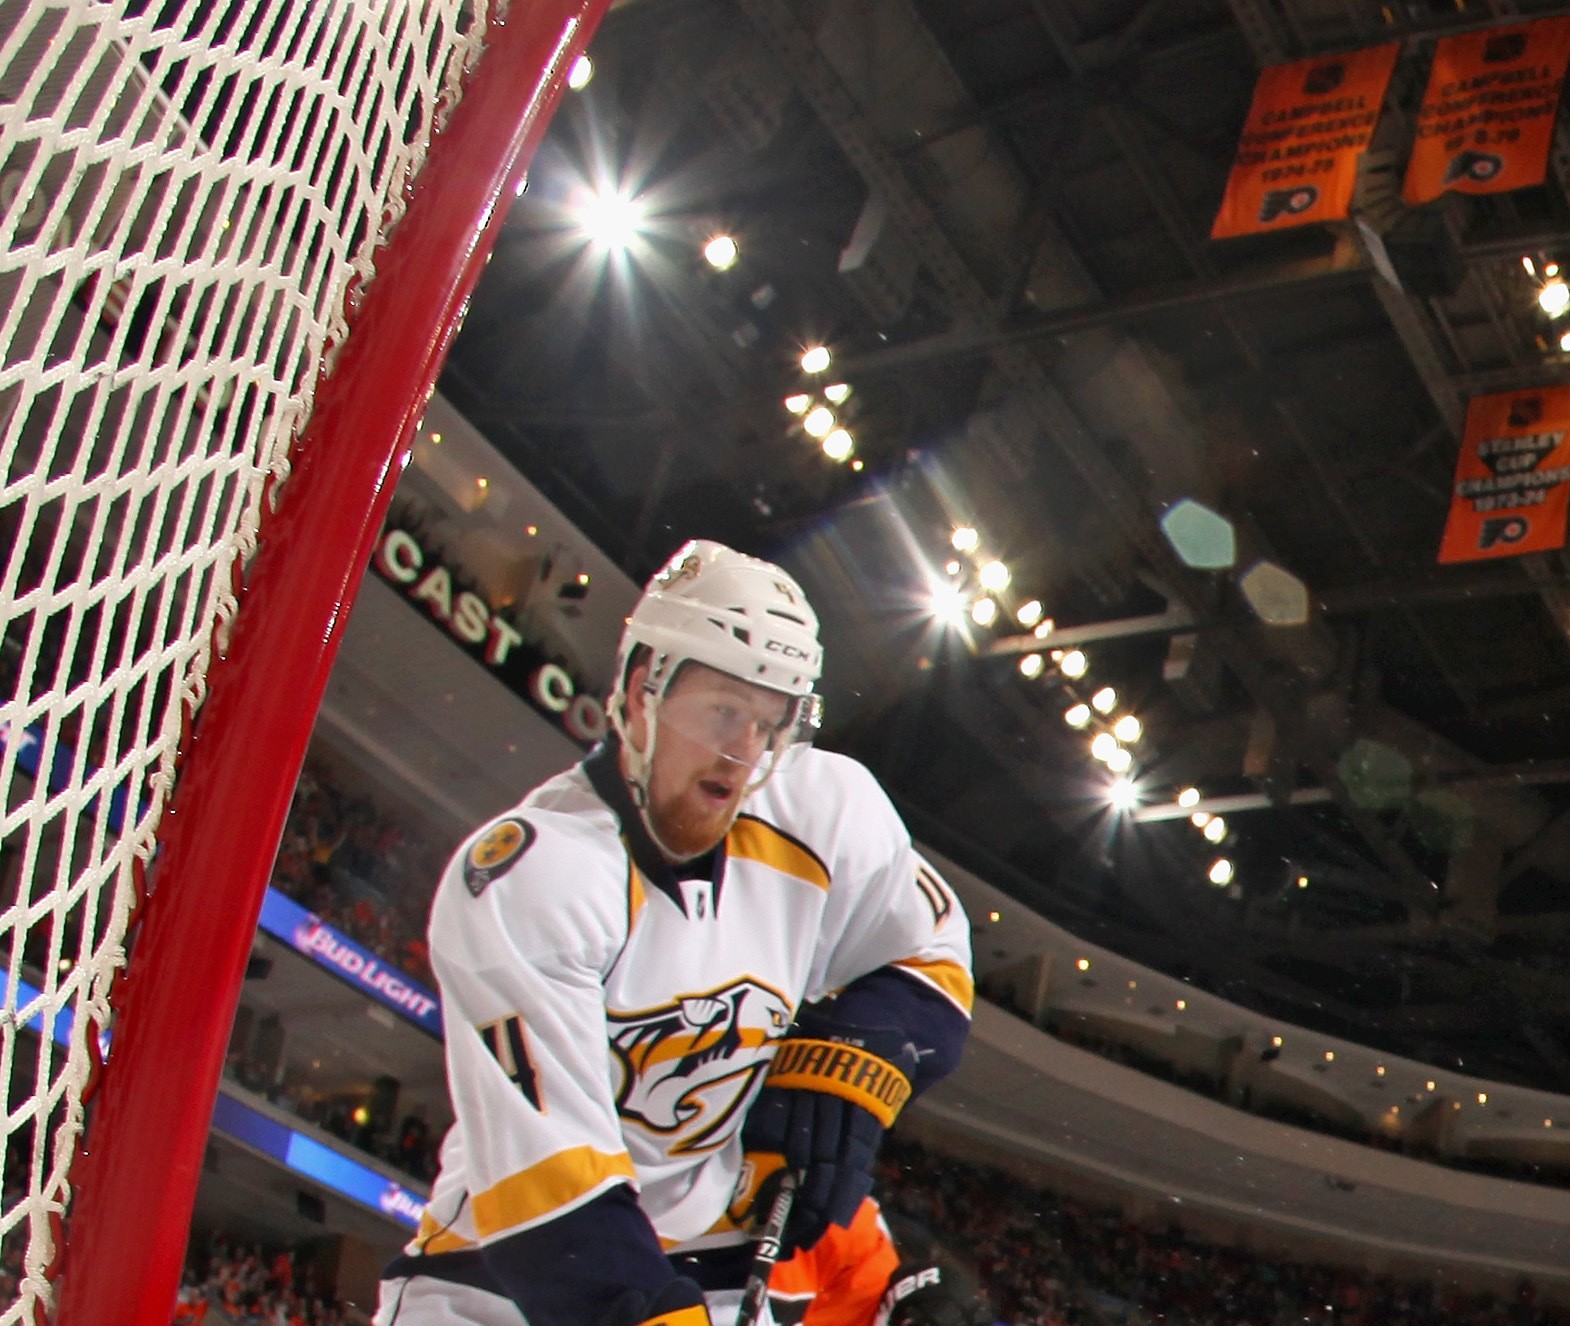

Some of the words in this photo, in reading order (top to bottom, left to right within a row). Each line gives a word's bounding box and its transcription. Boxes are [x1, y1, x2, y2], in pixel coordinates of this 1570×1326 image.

[1262, 95, 1365, 125] CAMPBELL
[1477, 431, 1565, 458] STANLEY
[1496, 449, 1536, 472] CUP
[1457, 467, 1570, 497] CHAMPIONS
[383, 530, 522, 663] CAST
[537, 664, 607, 742] CO
[765, 639, 809, 663] CCM
[308, 927, 368, 978] BUD
[363, 964, 437, 1016] LIGHT
[771, 1044, 908, 1107] WARRIO
[887, 1266, 942, 1312] UER
